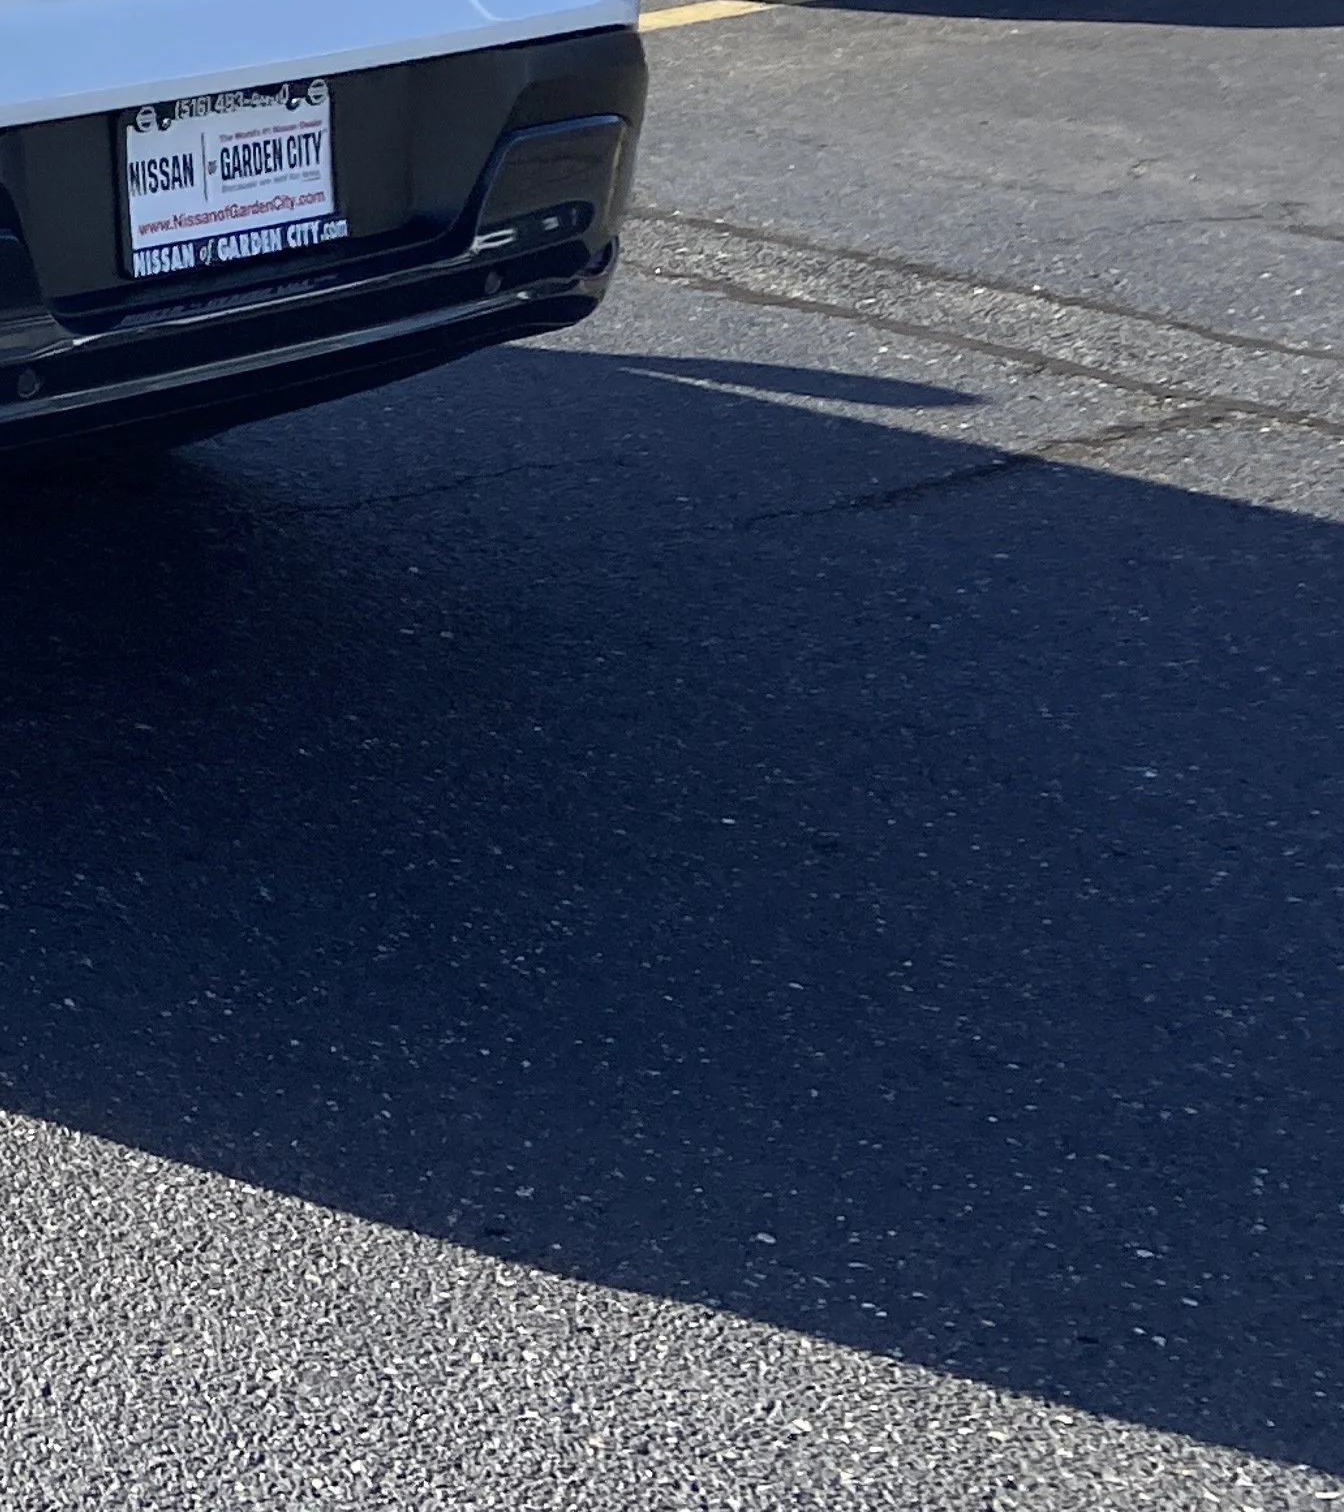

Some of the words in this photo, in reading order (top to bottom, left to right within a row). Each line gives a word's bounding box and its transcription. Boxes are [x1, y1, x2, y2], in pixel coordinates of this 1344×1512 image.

[127, 152, 195, 197] NISSAN
[220, 137, 283, 181] GARDEN
[286, 129, 322, 168] CITY
[133, 242, 196, 279] NISSAN
[199, 238, 215, 266] of
[217, 228, 283, 262] GARDEN
